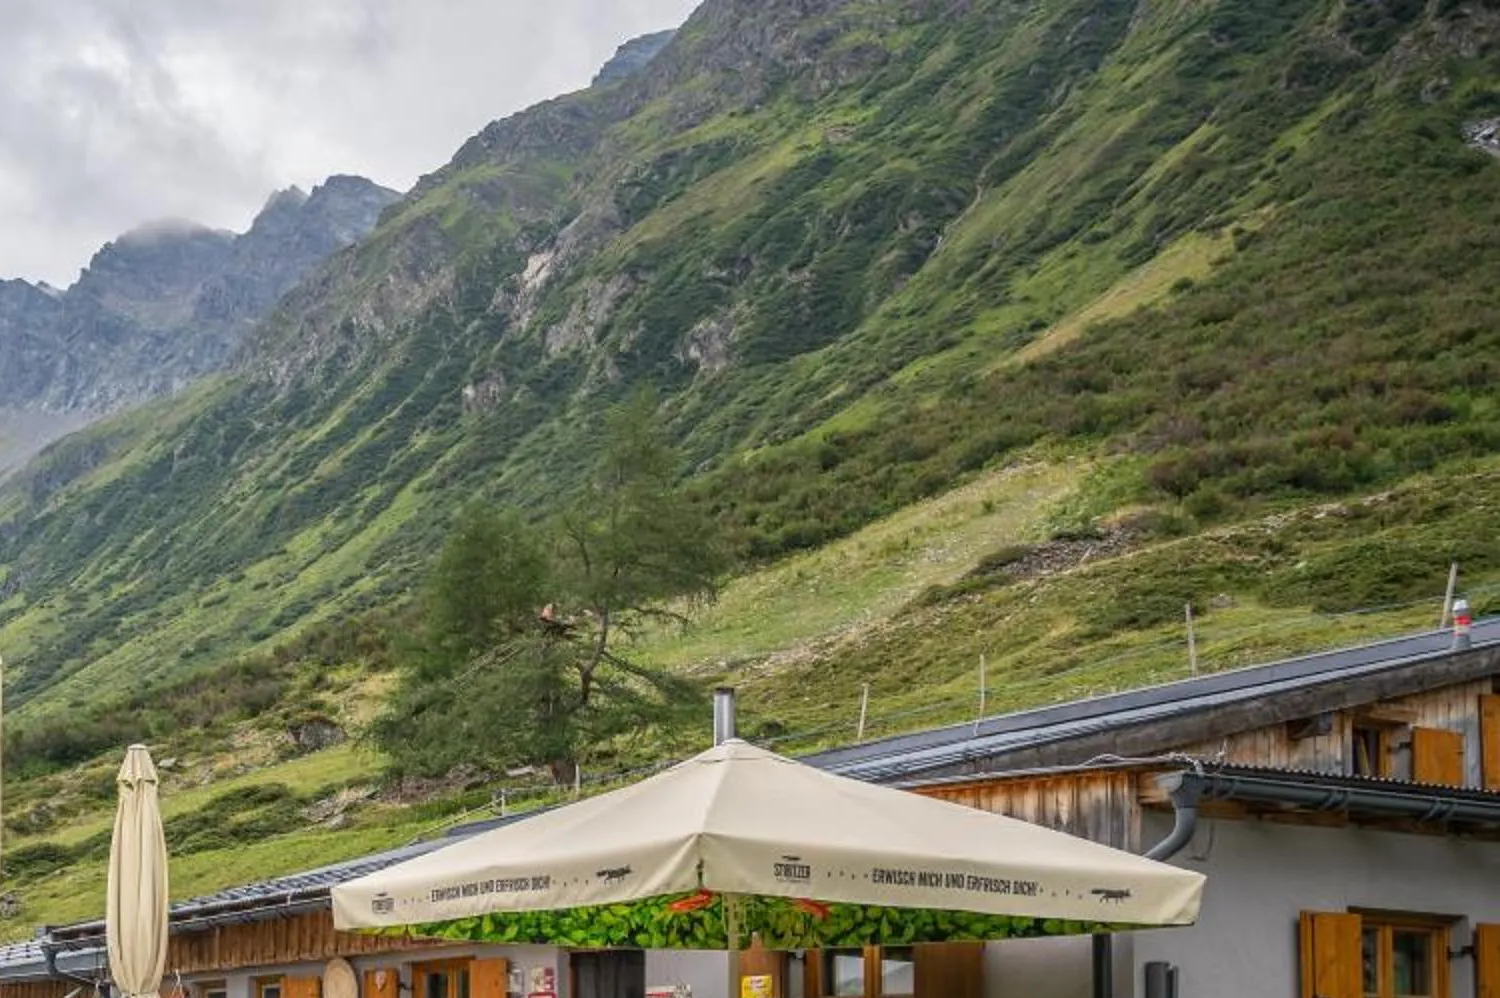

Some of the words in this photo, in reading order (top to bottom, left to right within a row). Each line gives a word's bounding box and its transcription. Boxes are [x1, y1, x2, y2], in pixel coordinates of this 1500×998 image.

[872, 868, 917, 887] ERWISCH
[918, 871, 943, 889] MICH
[945, 872, 965, 889] UND
[966, 875, 1011, 895] ERFRISCH
